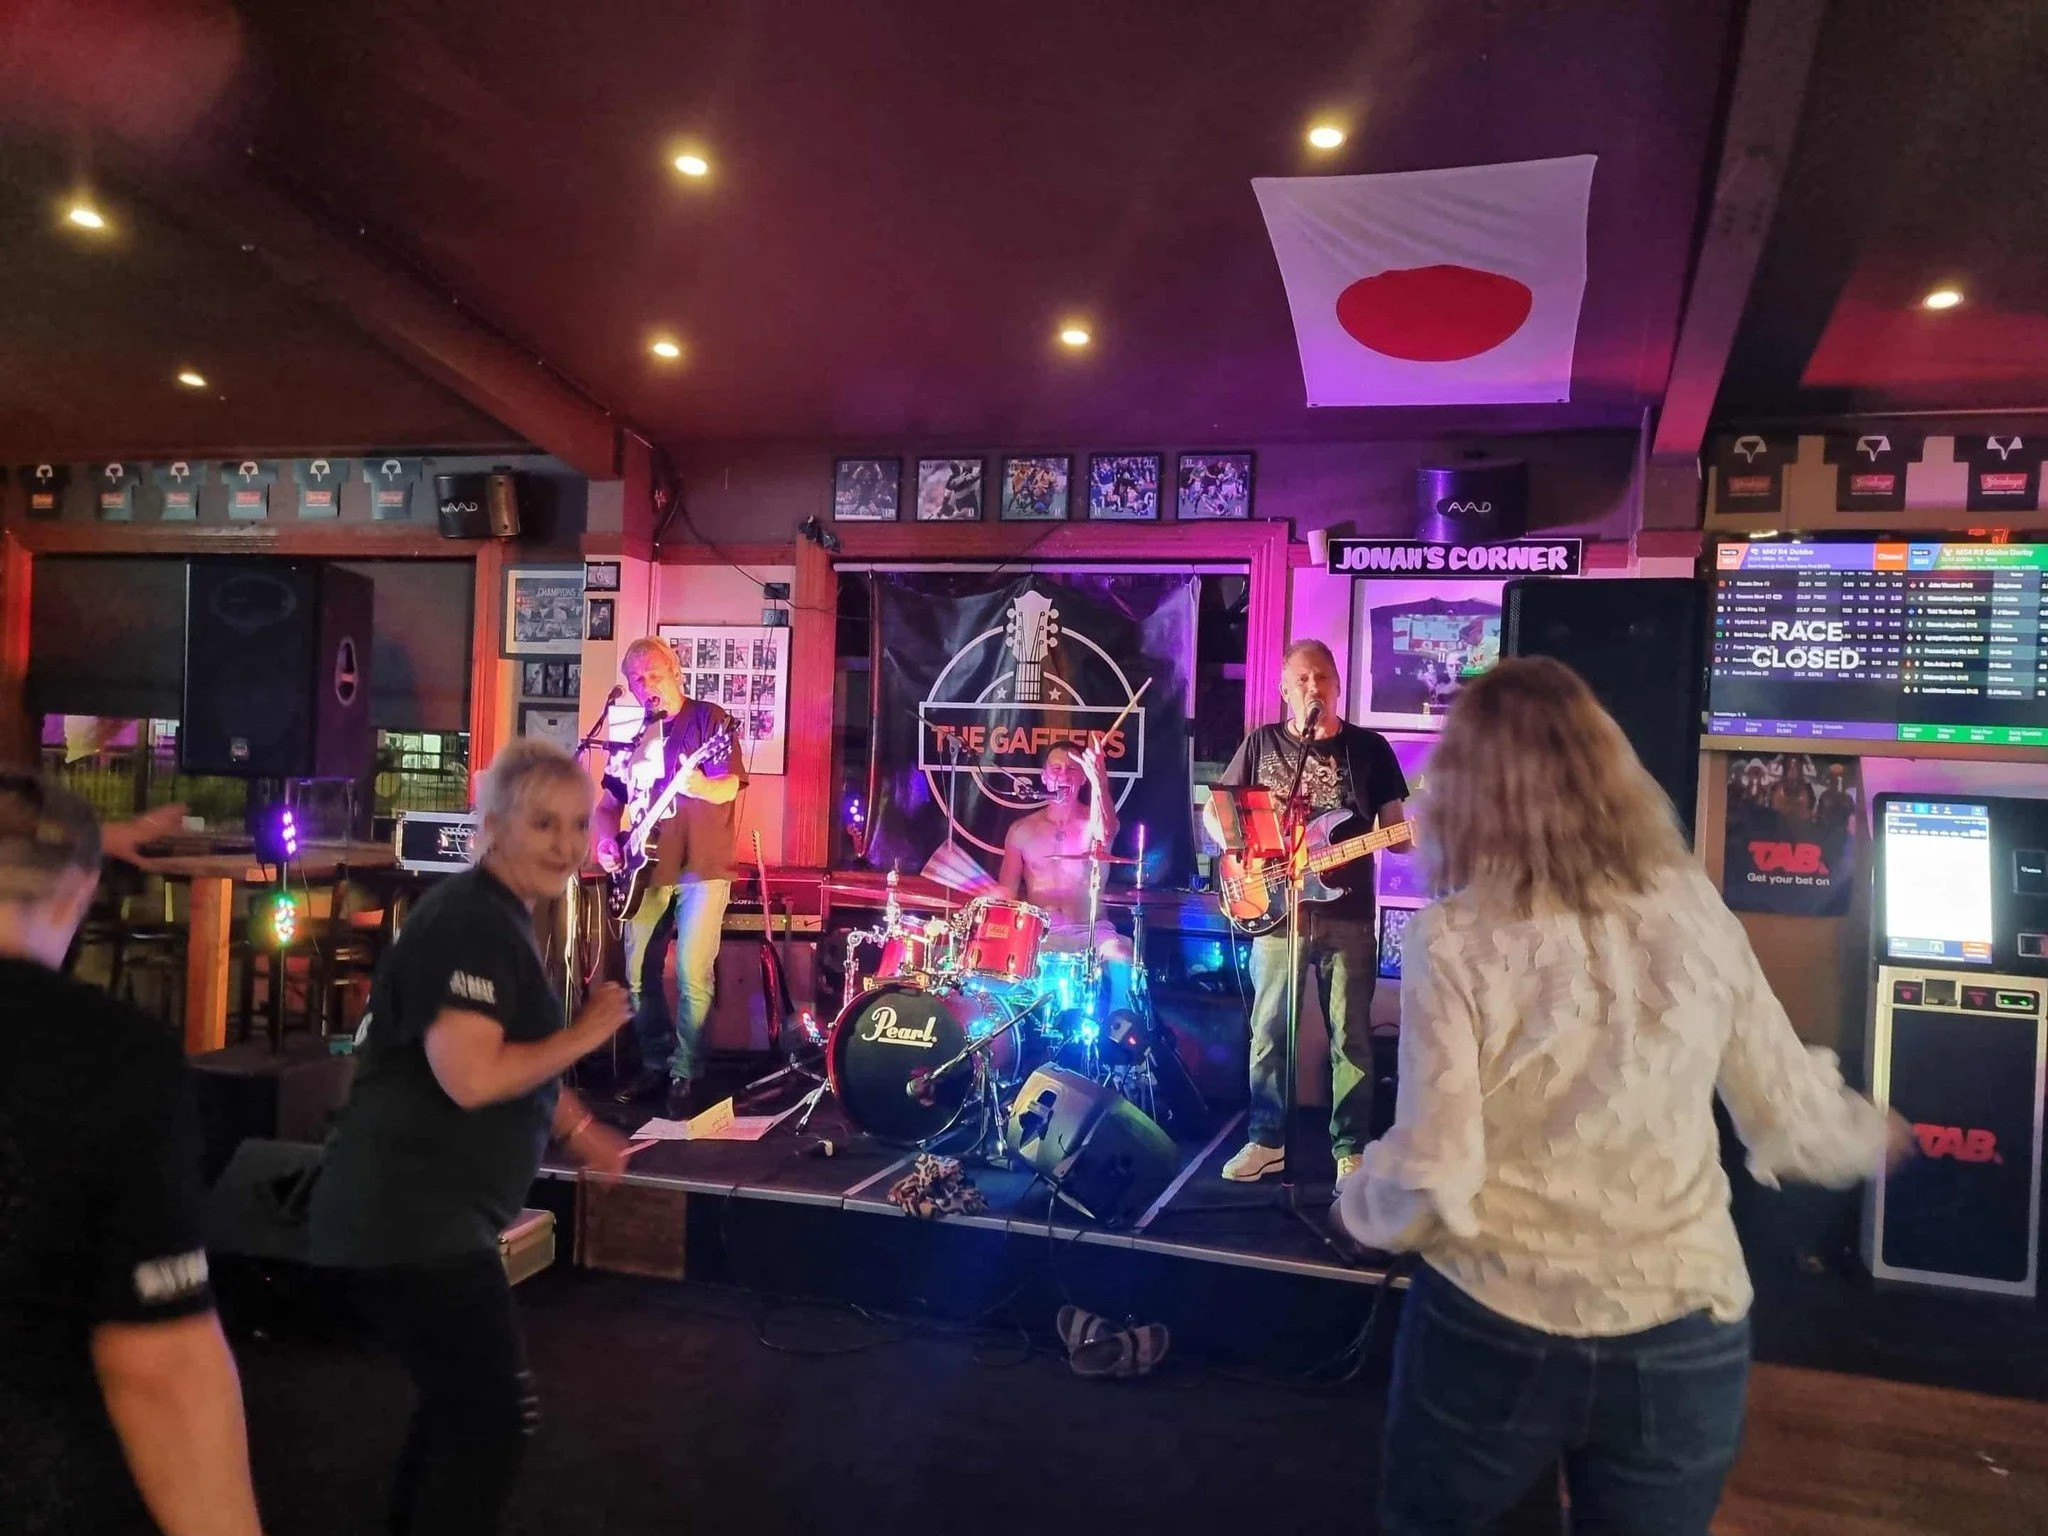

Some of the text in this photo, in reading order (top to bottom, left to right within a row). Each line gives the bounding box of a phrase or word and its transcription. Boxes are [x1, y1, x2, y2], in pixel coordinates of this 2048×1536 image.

[1447, 501, 1491, 513] AAD
[1336, 546, 1568, 571] JONAH'S CORNER
[1771, 621, 1843, 642] RACE
[1752, 649, 1859, 670] CLOSED
[1747, 872, 1830, 887] Get your bet on
